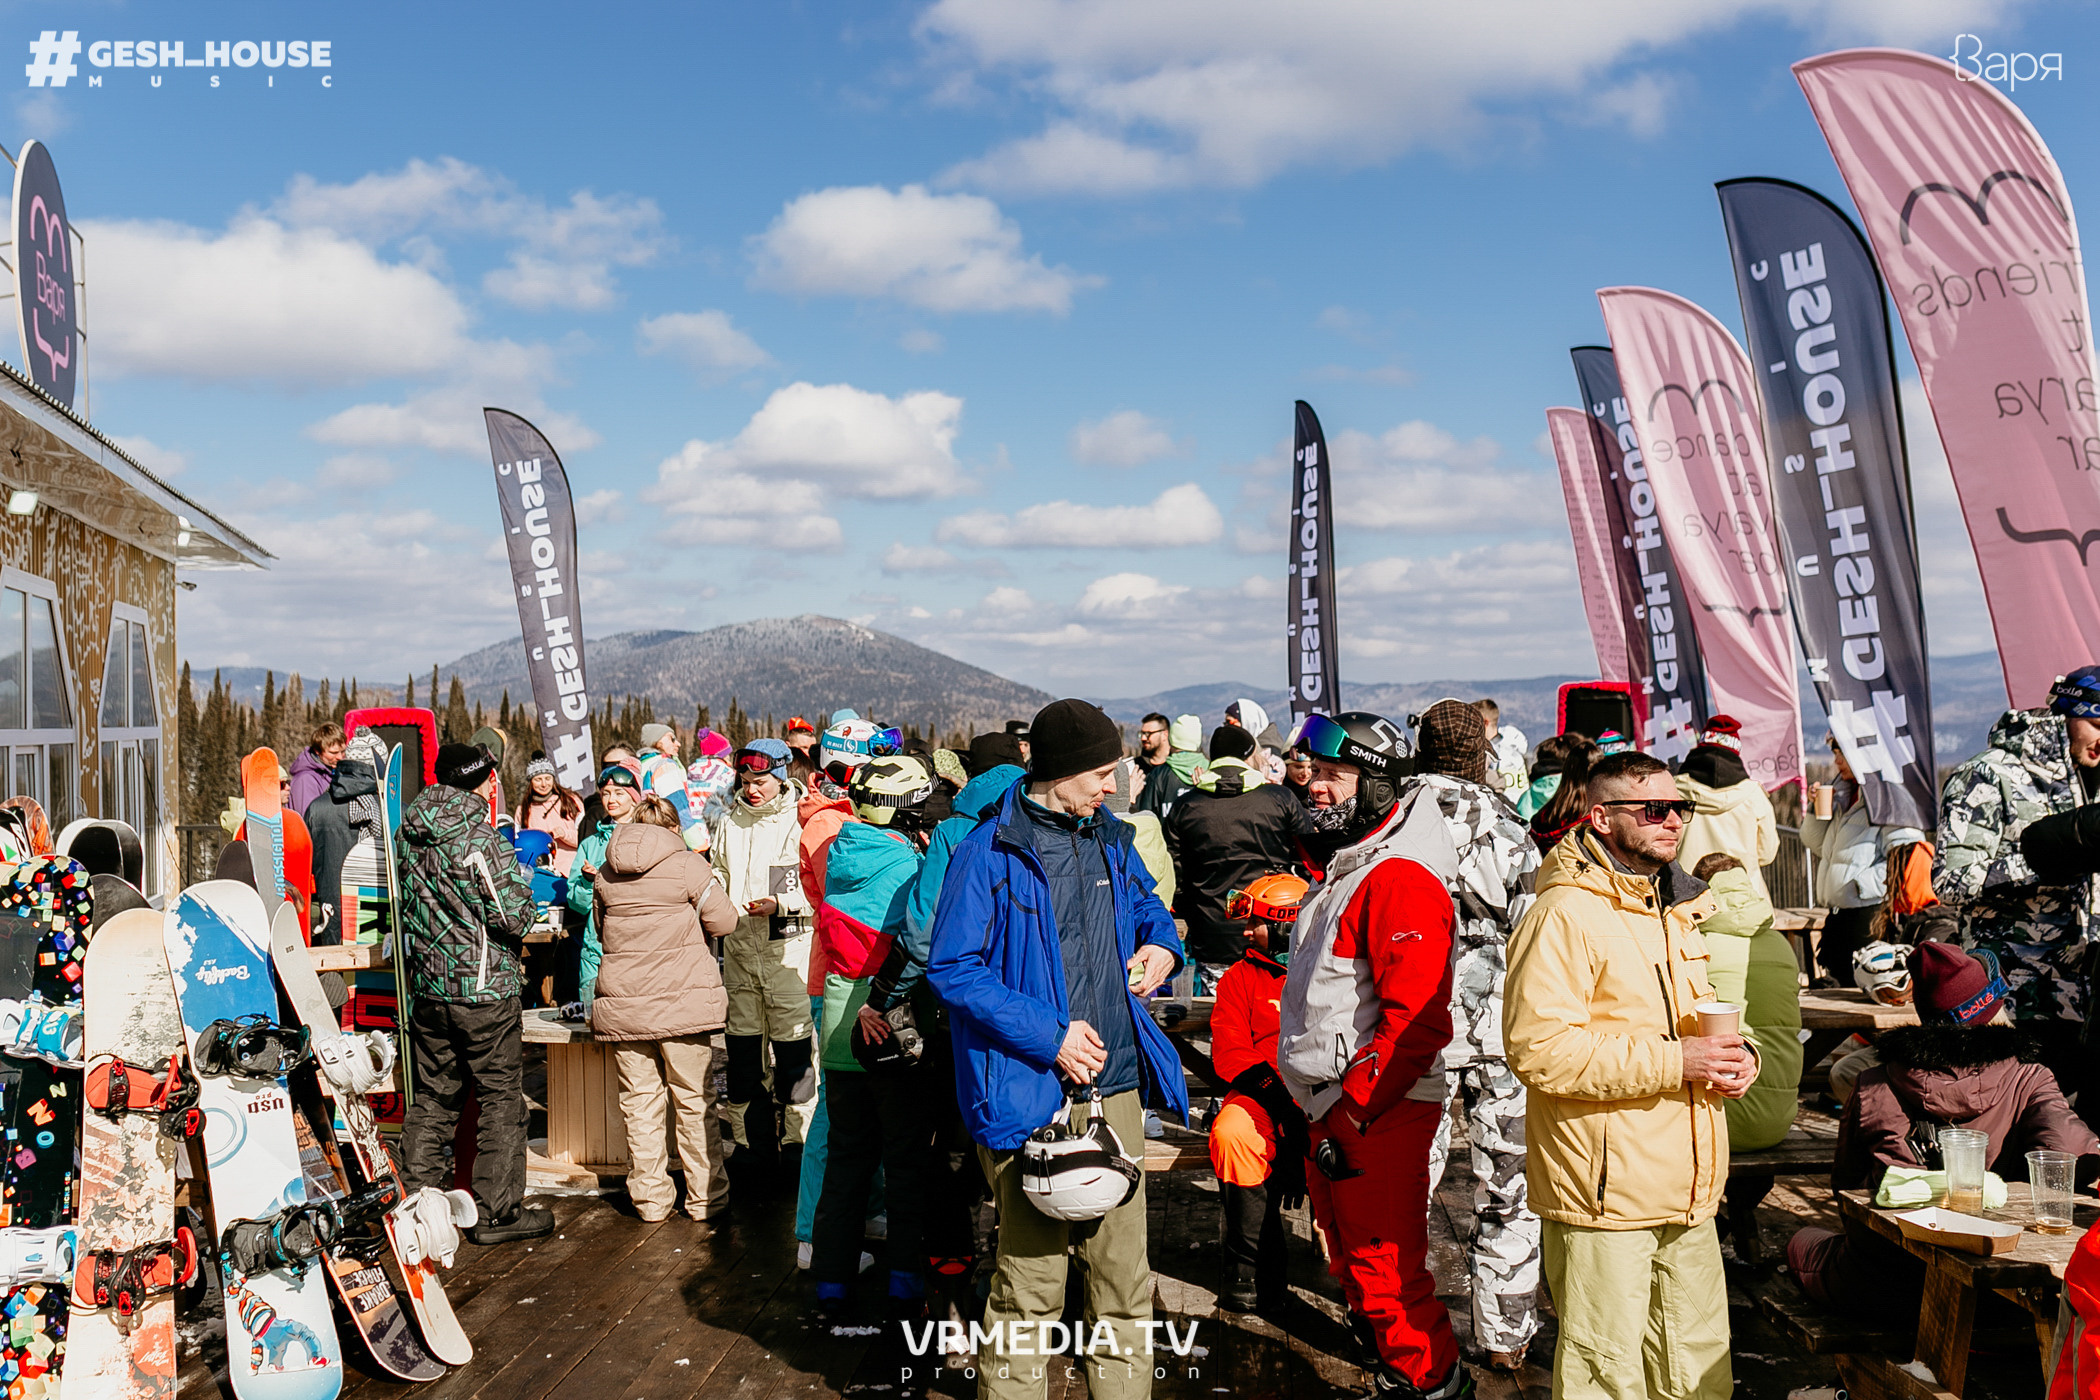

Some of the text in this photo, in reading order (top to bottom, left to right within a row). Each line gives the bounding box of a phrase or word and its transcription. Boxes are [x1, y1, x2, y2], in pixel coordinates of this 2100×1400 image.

[36, 250, 66, 325] Варя
[1349, 745, 1387, 768] SMITH
[62, 1186, 71, 1215] BRICKS
[353, 1266, 386, 1288] FORCE
[357, 1280, 391, 1312] DRAKE
